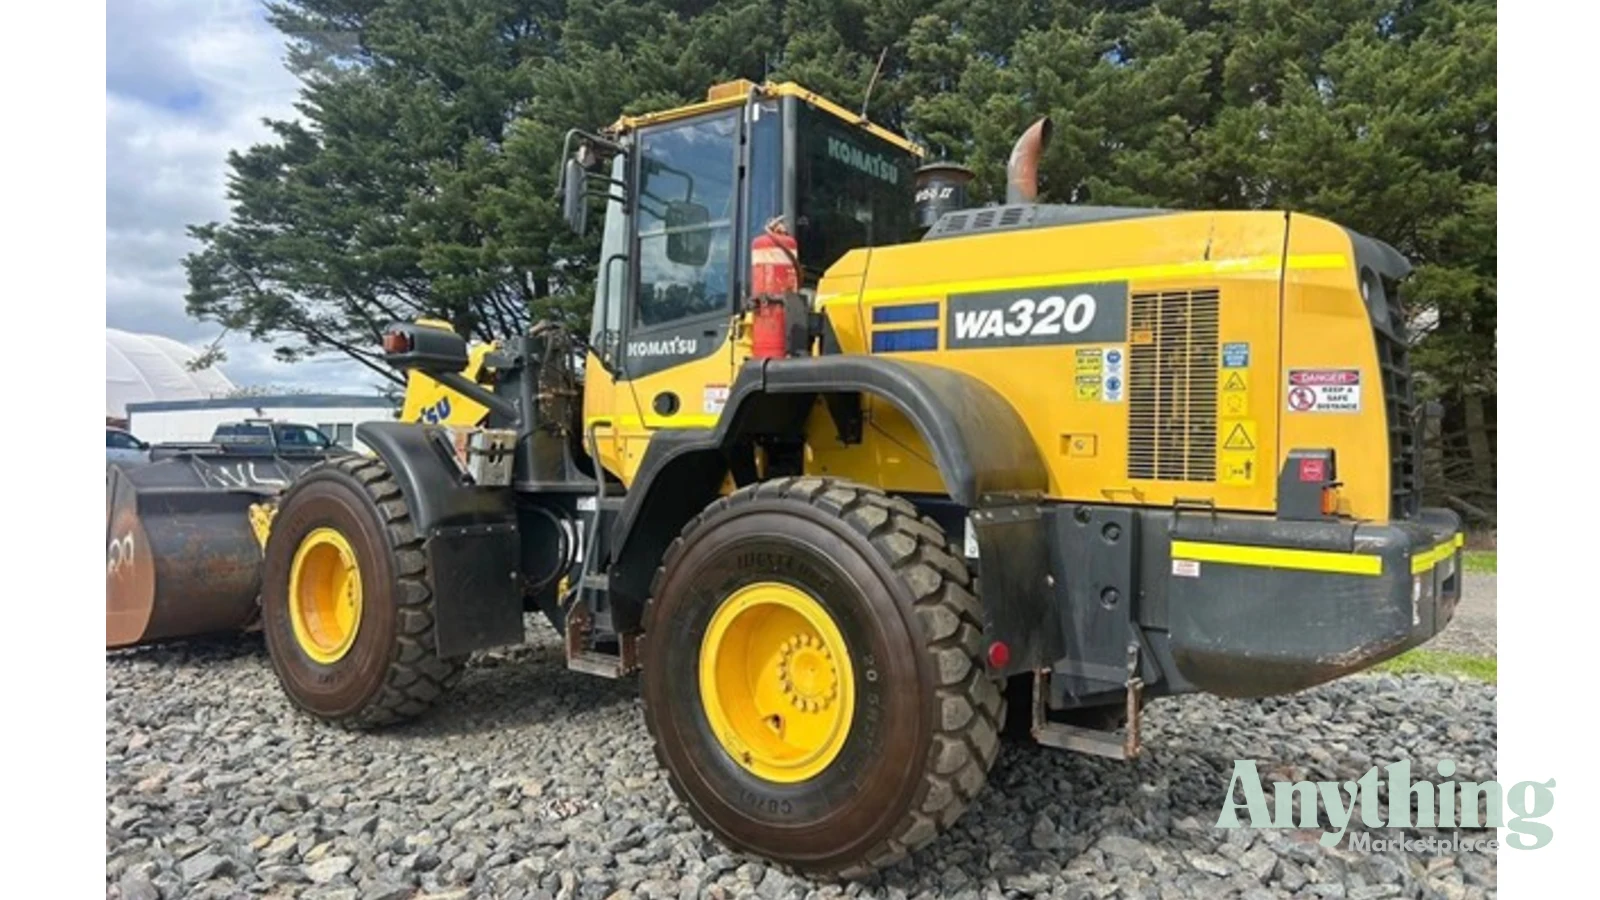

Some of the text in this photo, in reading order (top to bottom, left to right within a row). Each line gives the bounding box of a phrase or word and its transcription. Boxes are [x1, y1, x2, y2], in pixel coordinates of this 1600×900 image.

[828, 137, 898, 184] KOMATSU
[955, 294, 1097, 339] WA320
[627, 335, 697, 356] KOMATSU
[1301, 372, 1347, 383] DANGER
